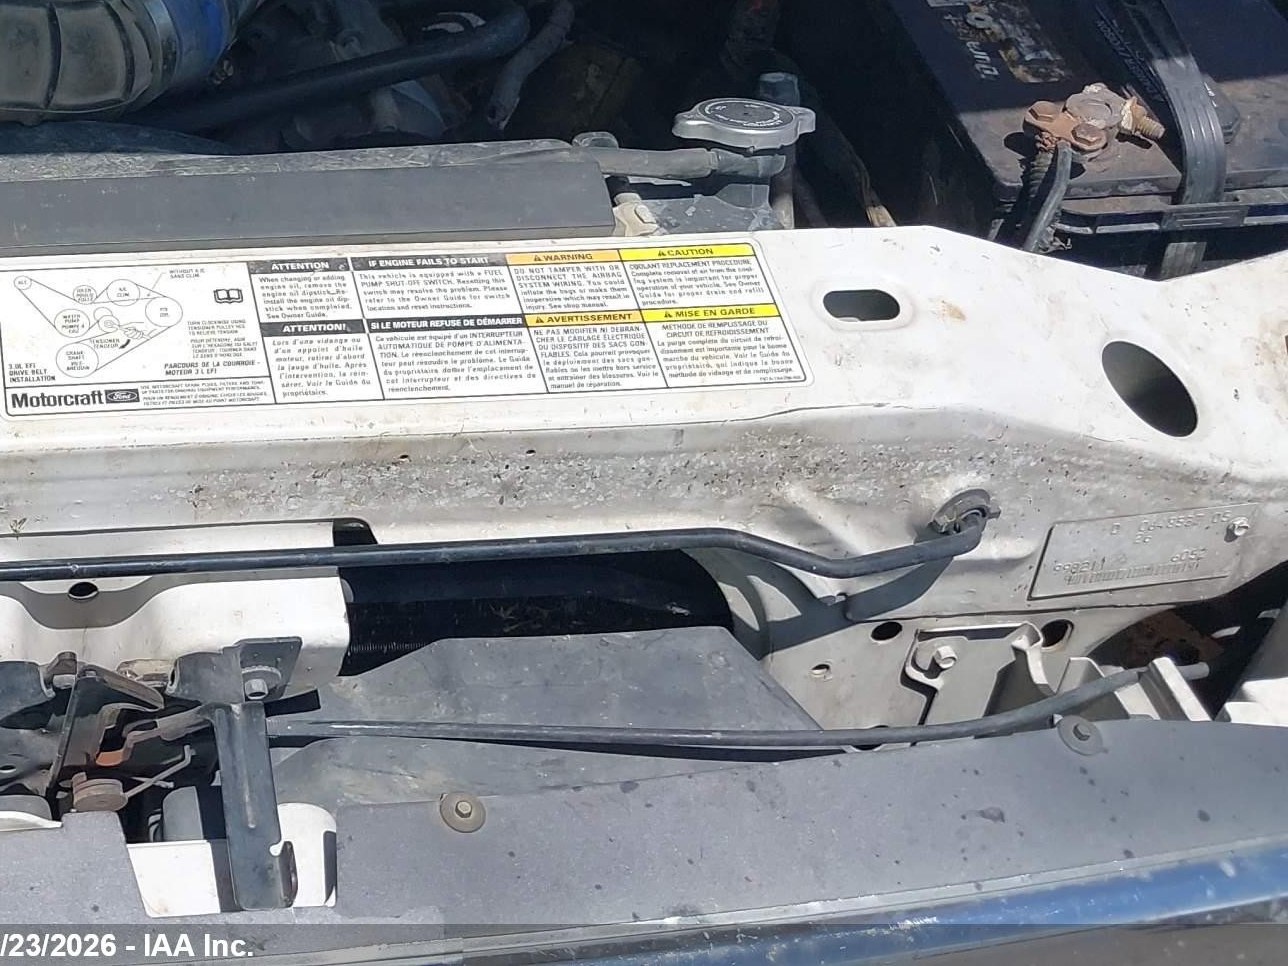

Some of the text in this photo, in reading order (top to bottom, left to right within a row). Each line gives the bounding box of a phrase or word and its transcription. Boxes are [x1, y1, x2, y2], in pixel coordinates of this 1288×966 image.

[666, 248, 714, 256] CAUTION
[458, 256, 490, 264] START
[543, 253, 593, 261] WARNING
[271, 261, 329, 270] ATTENTION
[719, 307, 756, 315] GARDE
[546, 313, 634, 323] AVERTISSEMENT
[381, 321, 391, 329] LE
[393, 320, 428, 328] MOTEUR
[429, 319, 461, 327] REFUSE
[463, 318, 475, 326] DE
[476, 317, 522, 326] DÉMARRER
[283, 323, 345, 332] ATTENTION!
[164, 361, 198, 369] PARCOURS
[11, 390, 103, 408] Motorcraft
